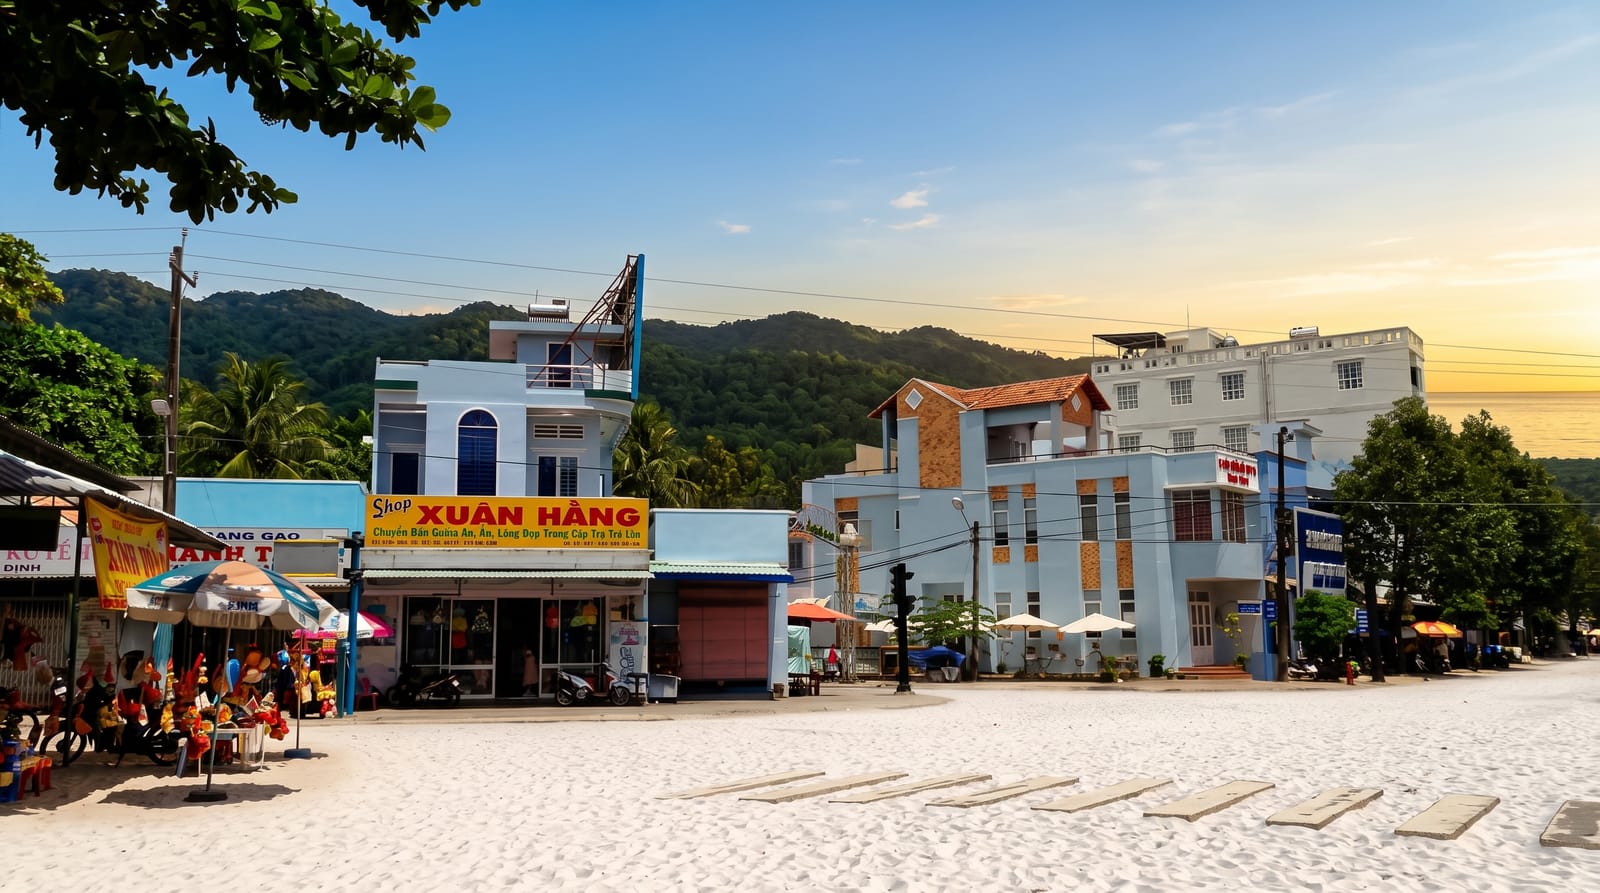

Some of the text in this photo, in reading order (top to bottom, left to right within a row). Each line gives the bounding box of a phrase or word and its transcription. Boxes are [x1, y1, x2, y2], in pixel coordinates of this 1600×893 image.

[372, 498, 412, 519] Shop
[416, 502, 523, 526] XUÂN
[261, 532, 300, 541] GAO
